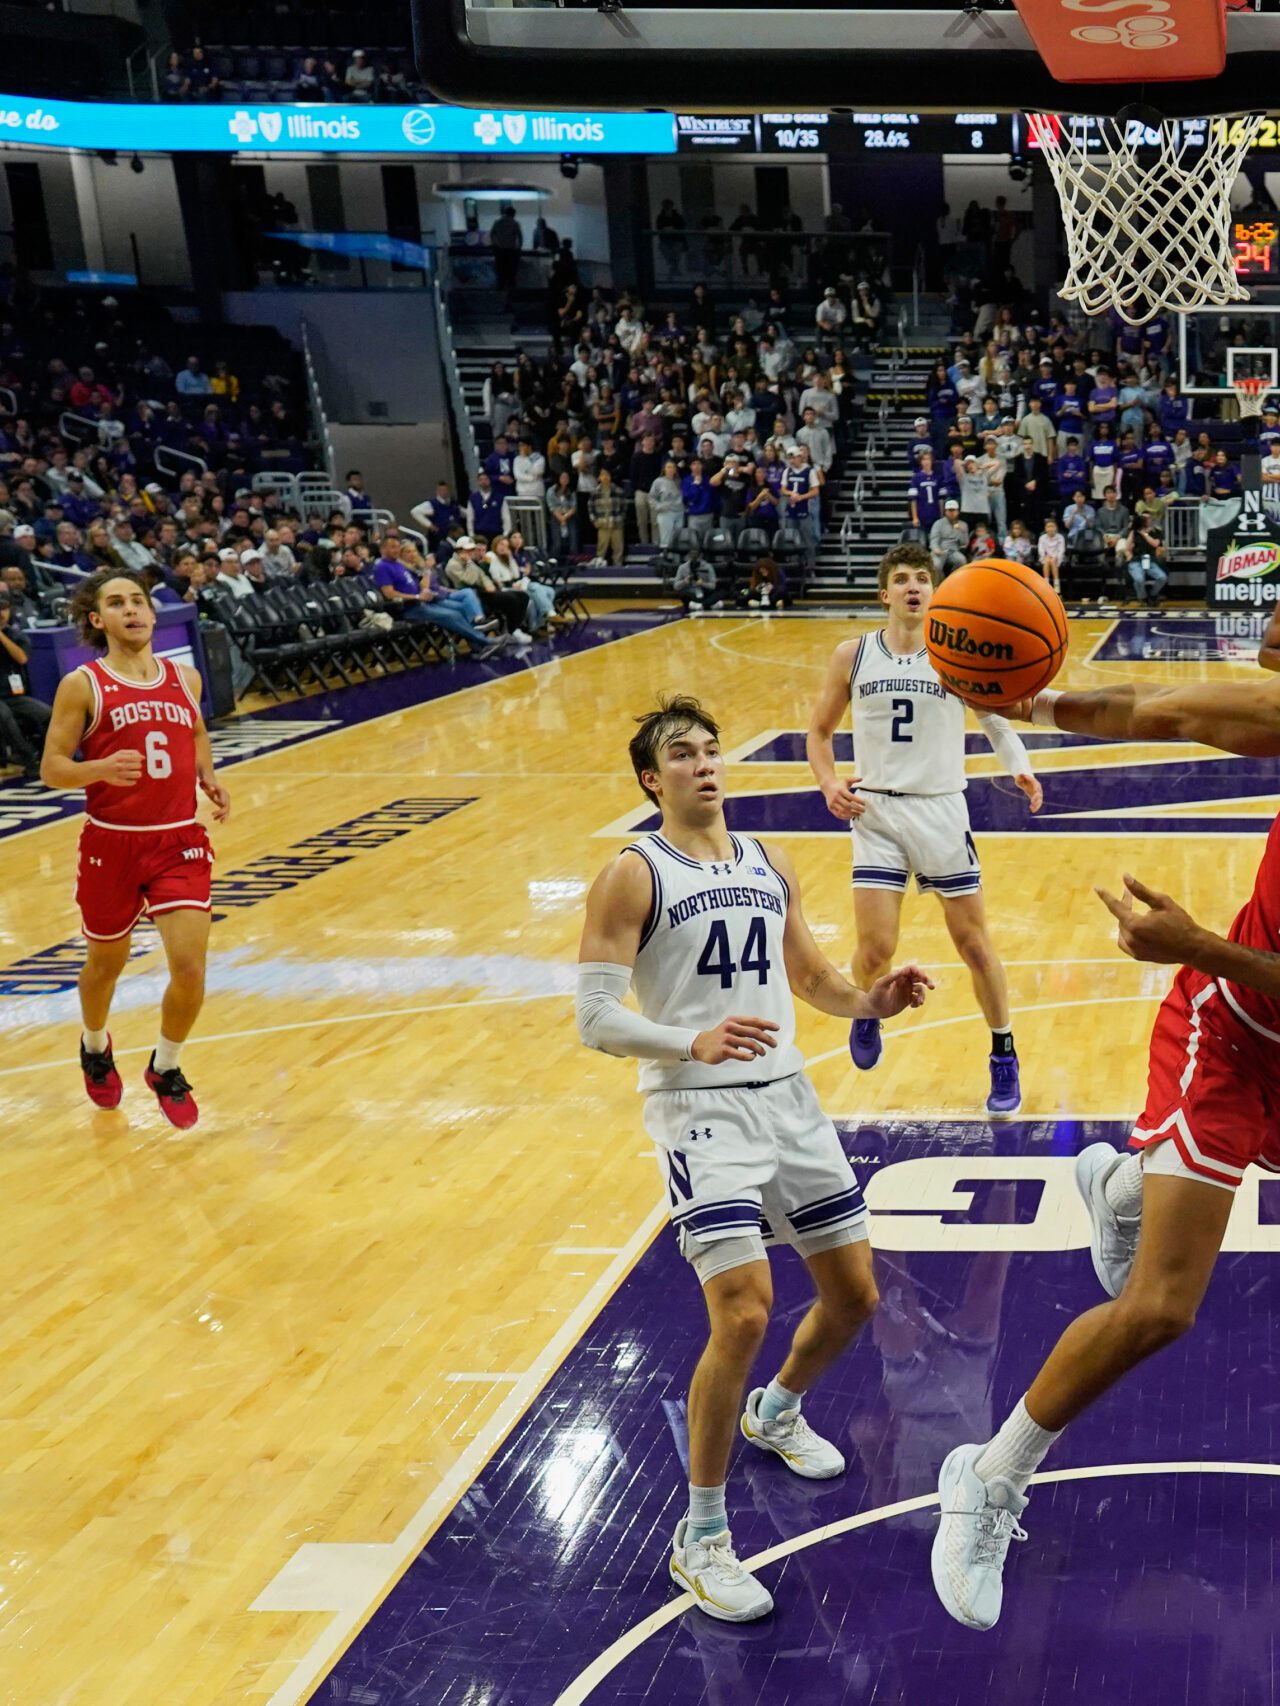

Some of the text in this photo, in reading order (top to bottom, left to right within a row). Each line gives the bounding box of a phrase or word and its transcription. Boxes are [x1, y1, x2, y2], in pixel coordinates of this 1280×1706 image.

[25, 108, 59, 131] do
[287, 115, 361, 141] Illinois
[531, 116, 605, 142] Illinois
[774, 128, 820, 148] 10/35
[864, 129, 910, 148] 28.6%
[970, 130, 983, 148] 8
[1234, 242, 1271, 274] 24
[1243, 490, 1260, 513] N
[1216, 547, 1279, 581] LIBMAN
[929, 617, 1014, 661] Wilson
[859, 678, 947, 701] NORTHWESTERN
[940, 669, 1004, 697] NCAA
[109, 700, 193, 732] BOSTON
[890, 698, 914, 743] 2
[144, 730, 172, 779] 6
[667, 886, 784, 929] NORTHWESTERN
[696, 916, 771, 989] 44
[667, 1149, 694, 1208] N
